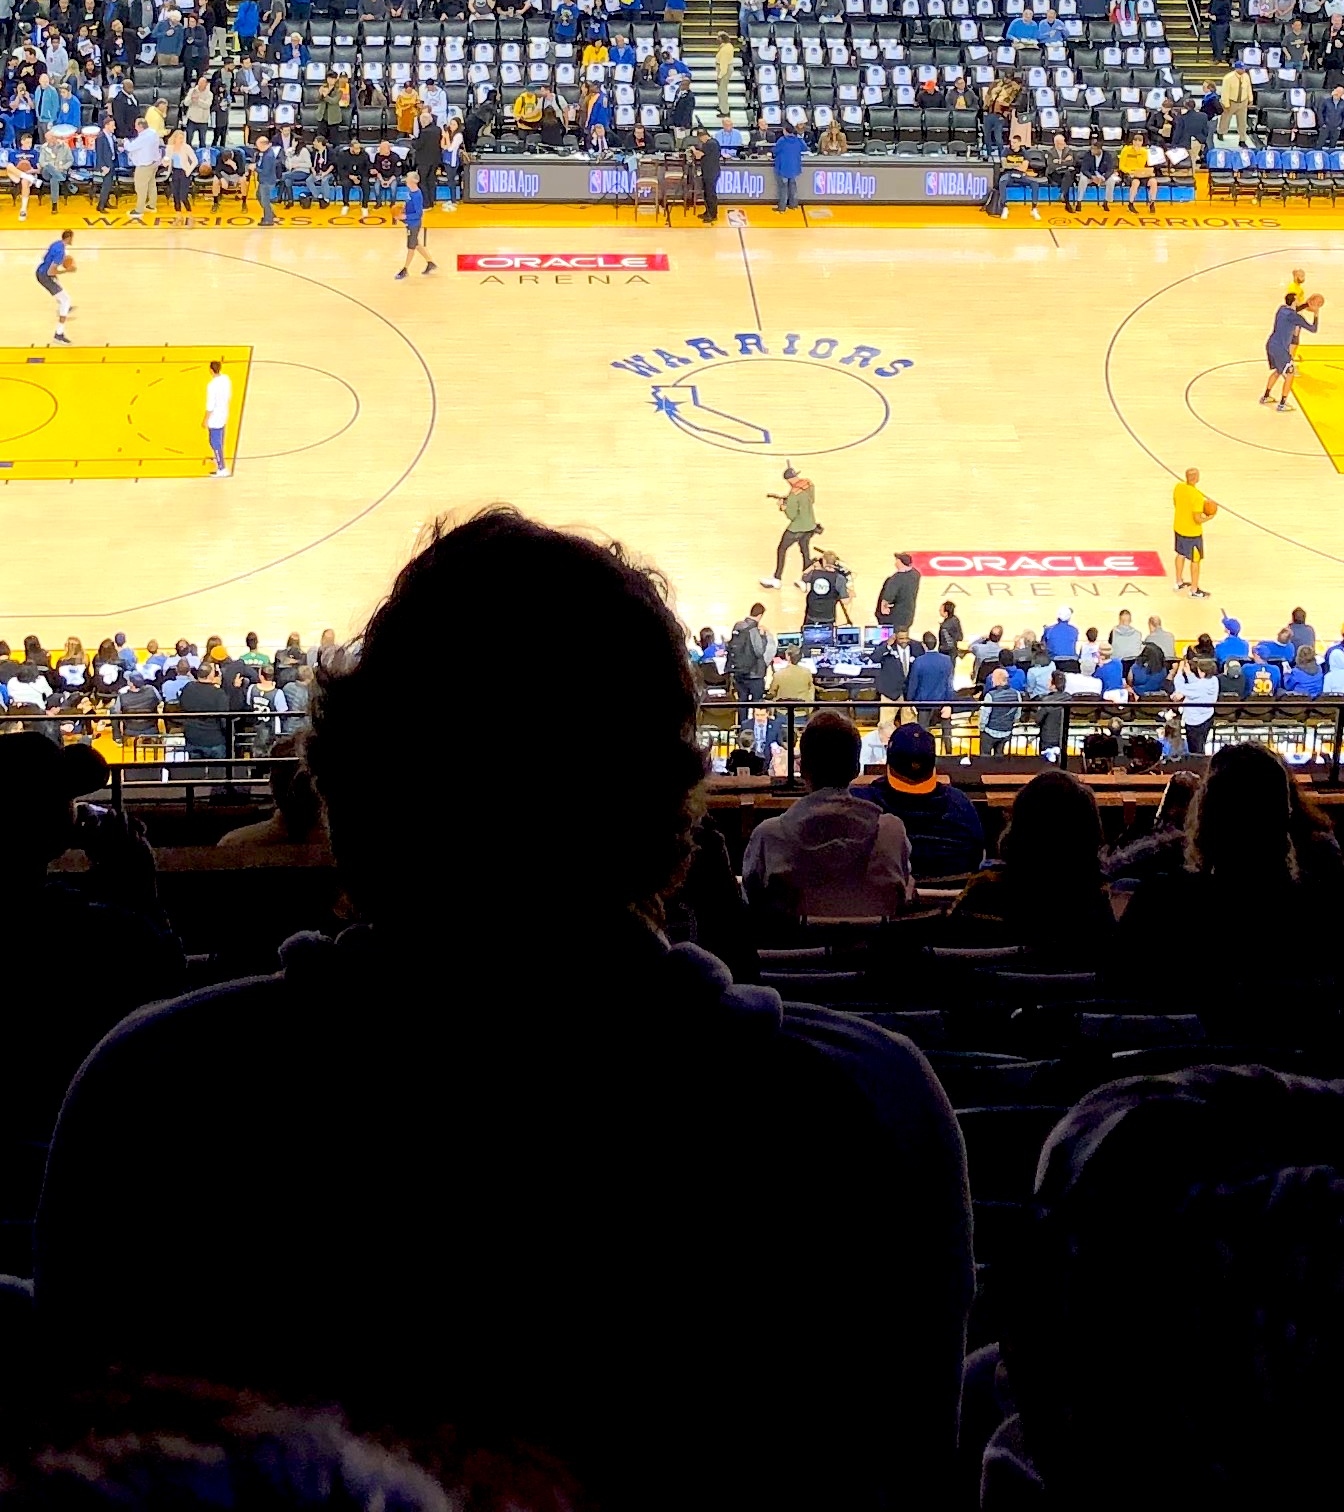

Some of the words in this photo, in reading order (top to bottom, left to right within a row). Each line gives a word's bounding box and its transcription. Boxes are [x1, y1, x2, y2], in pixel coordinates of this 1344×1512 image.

[489, 170, 515, 193] NBA
[516, 171, 539, 197] App
[740, 171, 764, 197] App
[827, 171, 852, 194] NBA
[852, 171, 876, 198] App
[938, 172, 963, 195] NBA
[964, 172, 987, 199] App
[1047, 215, 1281, 228] @WARRIORS
[477, 256, 648, 268] ORACLE
[480, 274, 651, 285] ARENA
[610, 332, 915, 379] WARRIORS
[929, 555, 1140, 573] ORACLE
[941, 582, 1150, 597] ARENA
[1253, 678, 1273, 694] 30
